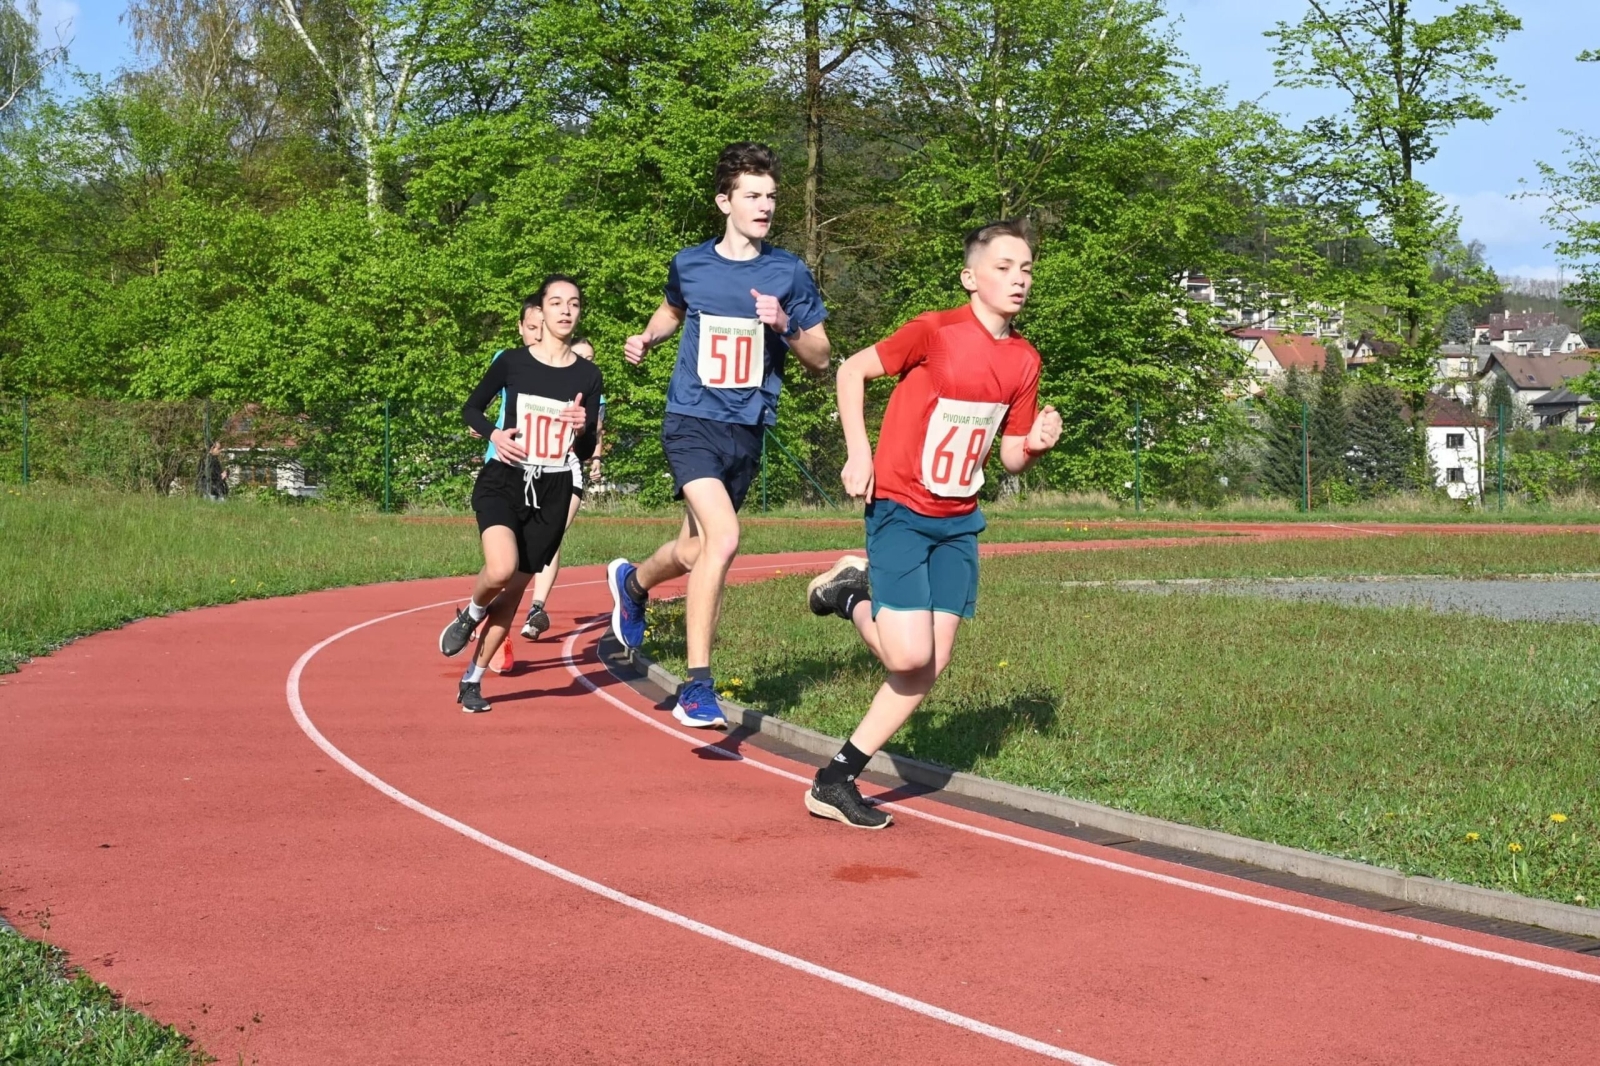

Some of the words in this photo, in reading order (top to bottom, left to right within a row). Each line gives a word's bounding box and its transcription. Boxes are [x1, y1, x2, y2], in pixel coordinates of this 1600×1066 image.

[709, 326, 731, 335] PIVOVAR
[709, 335, 752, 384] 50
[524, 403, 546, 413] PIVOVAR
[943, 413, 970, 424] PIVOVAR
[524, 413, 568, 459] 103
[931, 426, 986, 487] 68
